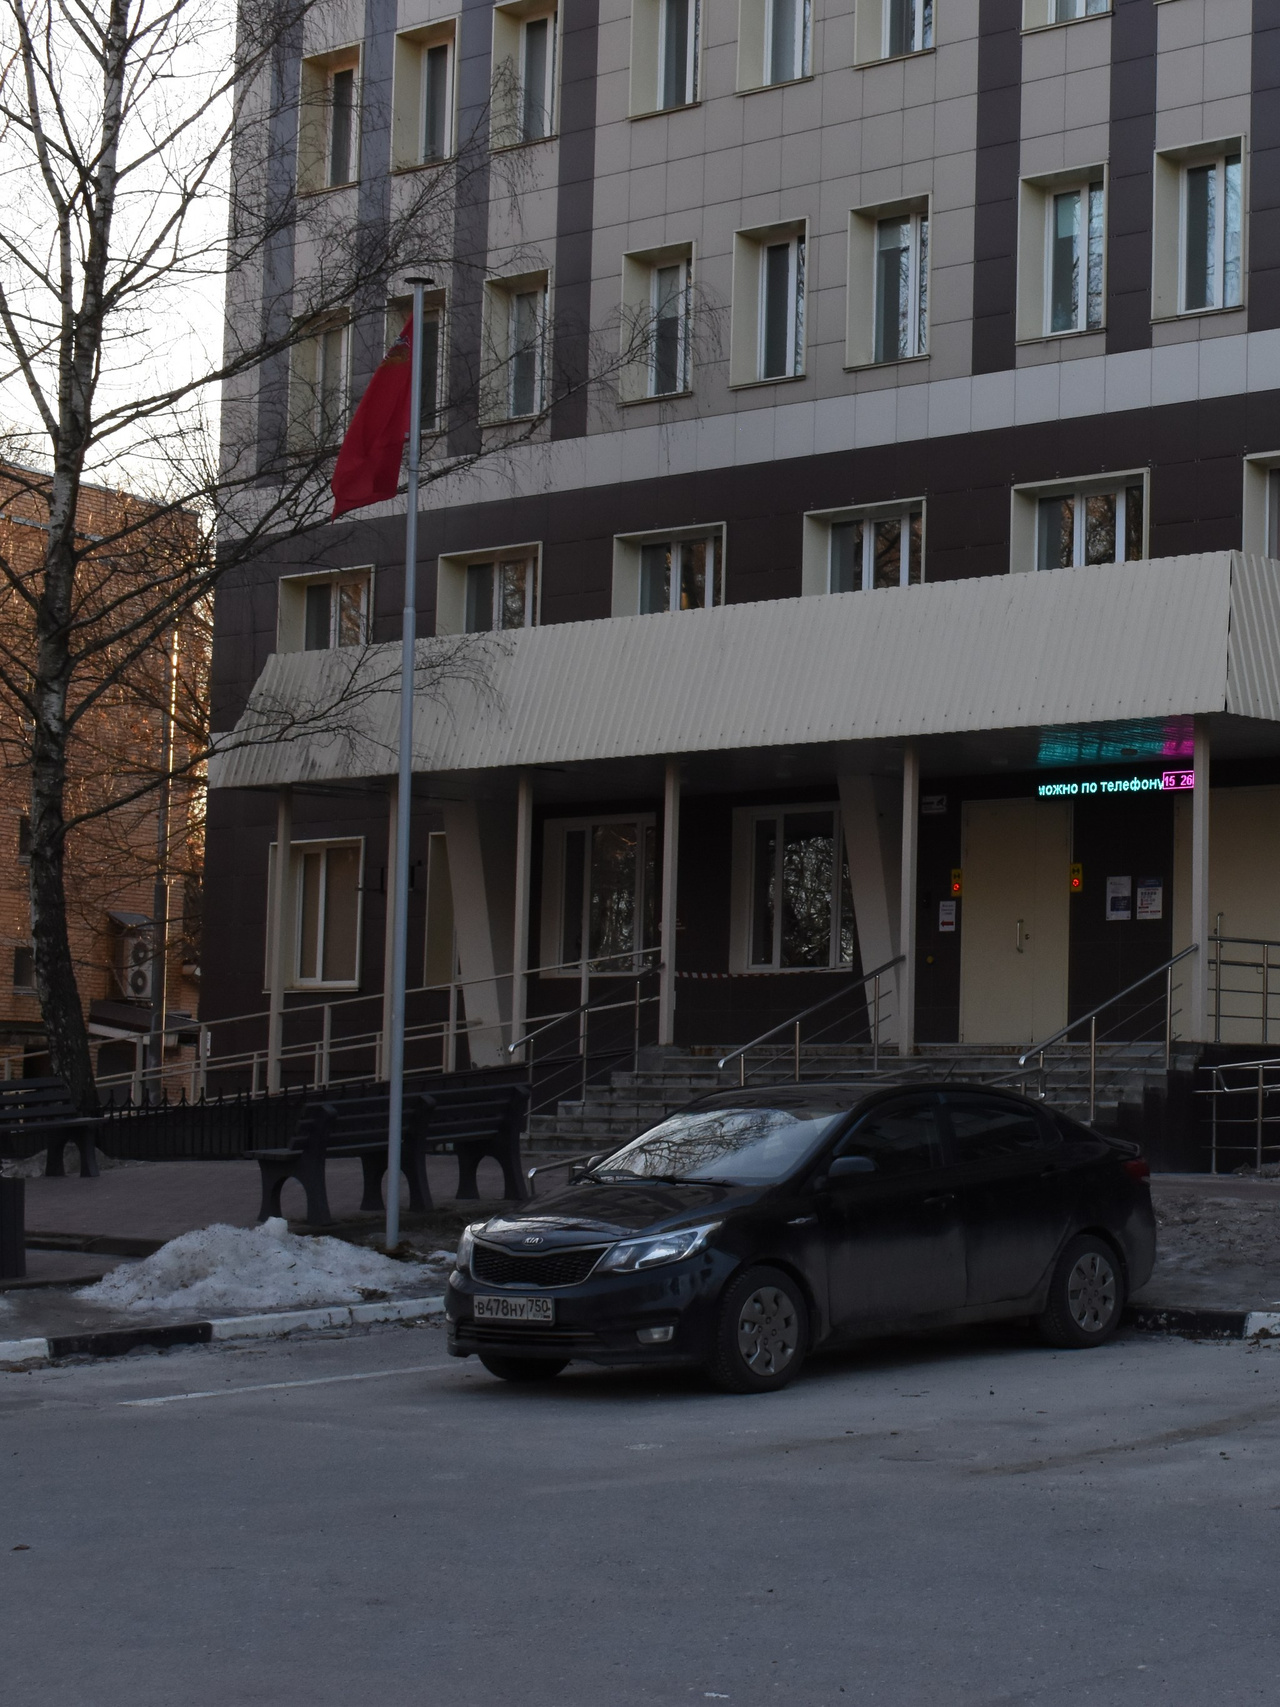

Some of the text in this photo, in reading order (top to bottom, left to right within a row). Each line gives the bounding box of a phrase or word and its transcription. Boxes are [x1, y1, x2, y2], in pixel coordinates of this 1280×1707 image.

[1164, 774, 1193, 787] 15 26
[1081, 782, 1098, 794] по
[528, 1298, 549, 1313] 750
